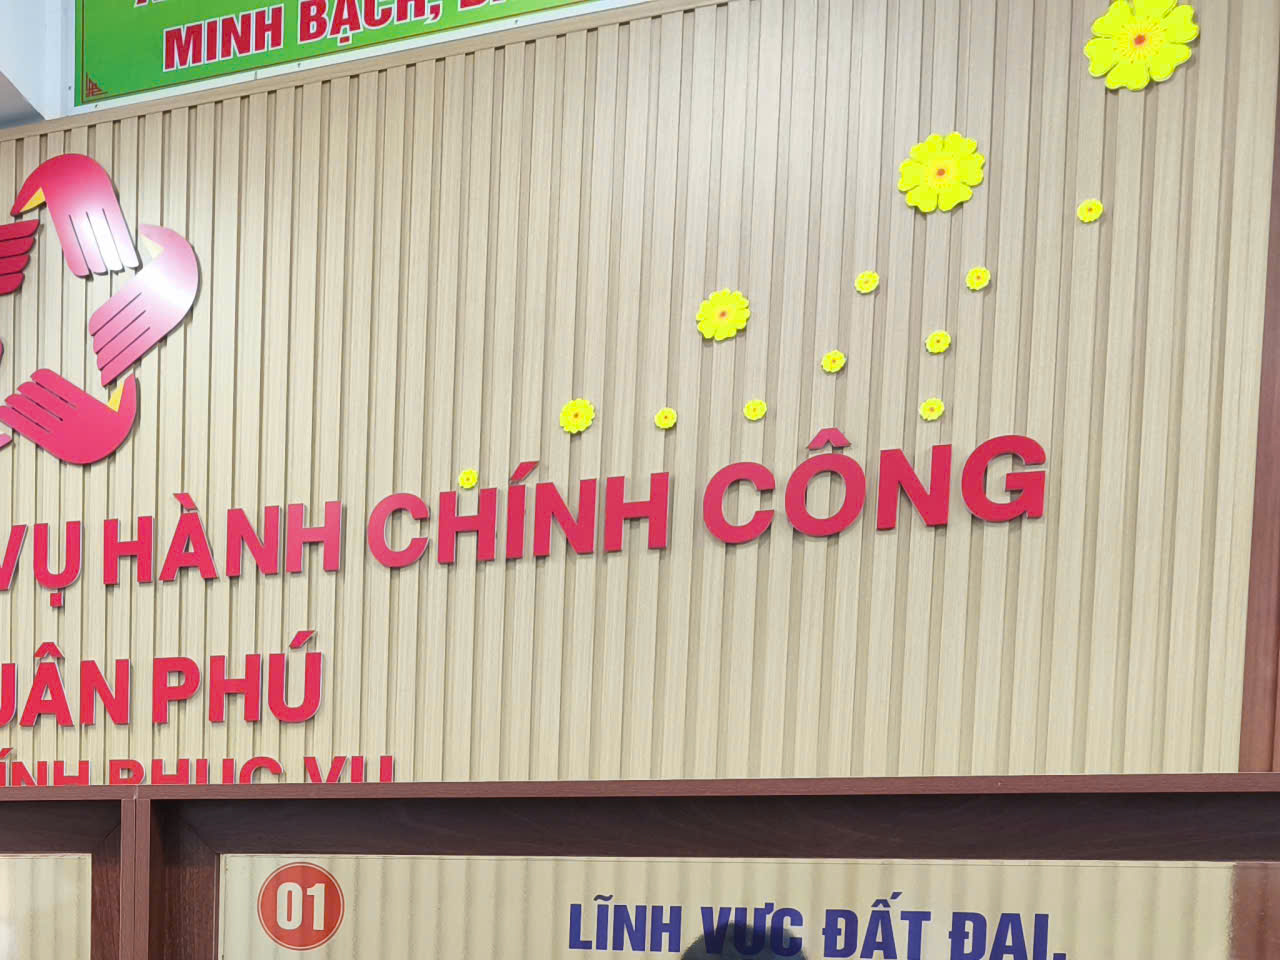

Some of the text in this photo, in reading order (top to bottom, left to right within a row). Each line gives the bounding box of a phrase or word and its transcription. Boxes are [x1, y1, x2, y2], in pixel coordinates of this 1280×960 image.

[165, 6, 283, 69] MINH
[103, 492, 341, 585] HÀNH
[368, 461, 669, 568] CHÍNH
[702, 427, 1046, 544] CÔNG
[153, 630, 322, 724] PHÚ
[277, 882, 325, 930] 01
[569, 894, 682, 953] LĨNH
[823, 891, 931, 960] ĐẤT
